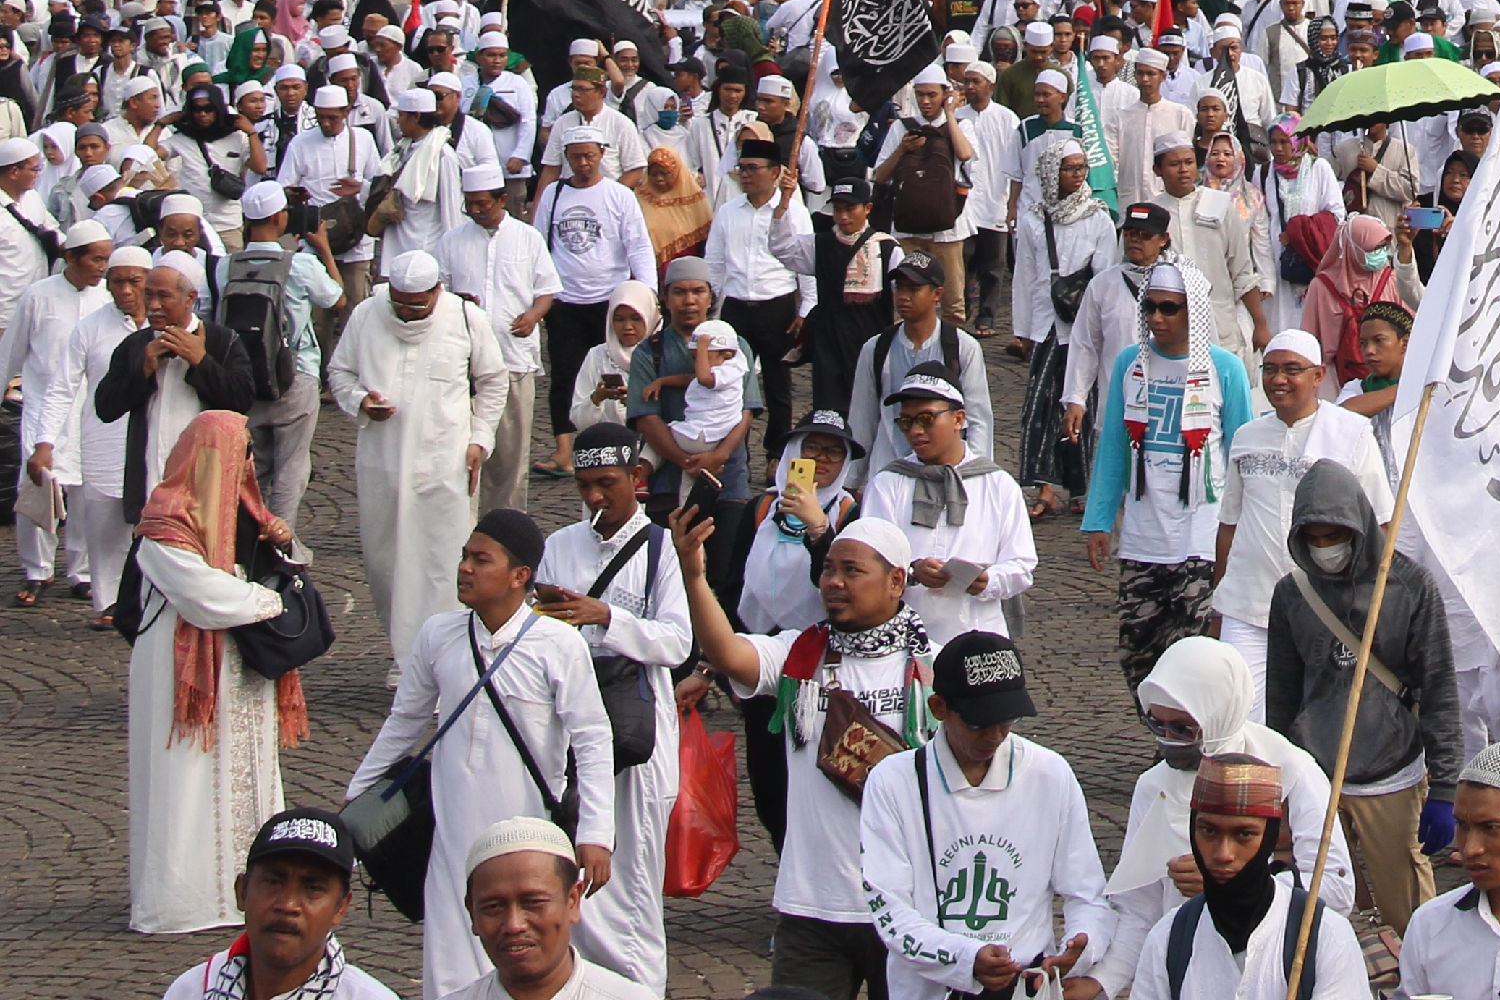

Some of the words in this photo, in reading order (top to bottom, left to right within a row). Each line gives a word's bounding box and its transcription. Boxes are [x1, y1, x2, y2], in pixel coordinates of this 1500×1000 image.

[857, 686, 905, 701] AKBA
[939, 835, 974, 868] REUNI
[977, 833, 1022, 869] ALUMNI
